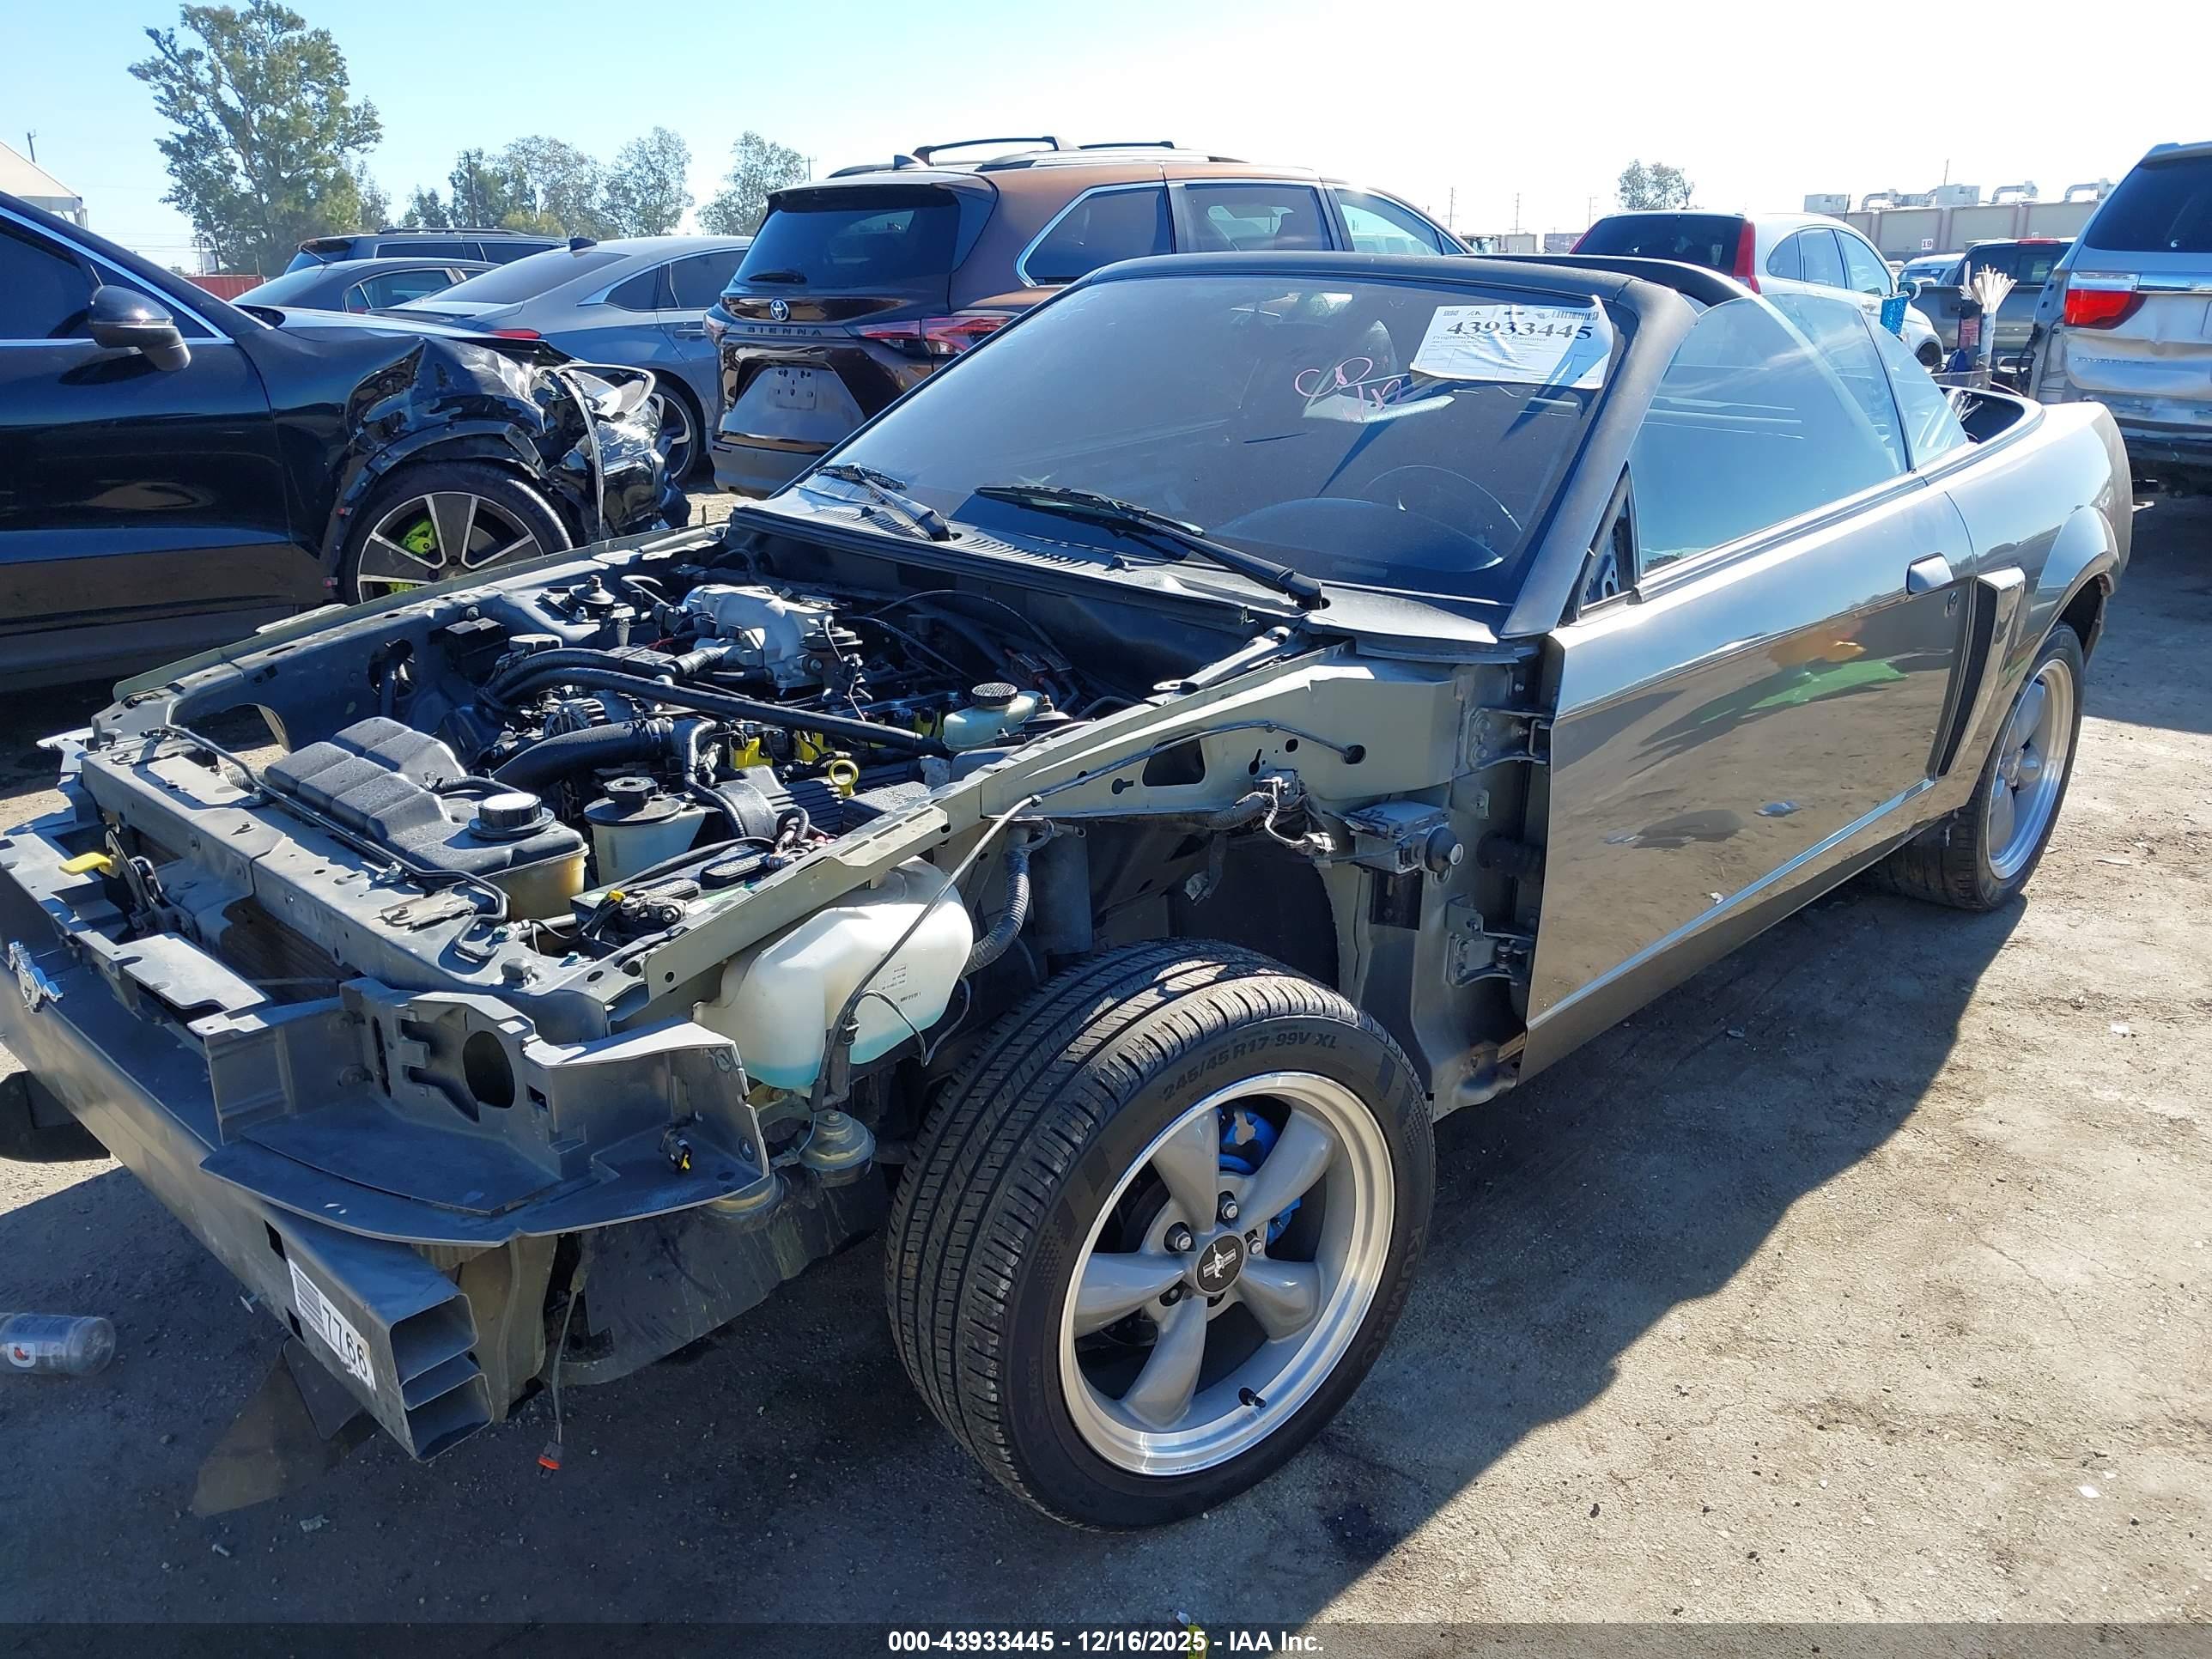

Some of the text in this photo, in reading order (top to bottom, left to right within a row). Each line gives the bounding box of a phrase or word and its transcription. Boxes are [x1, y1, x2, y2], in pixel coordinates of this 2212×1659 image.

[1922, 240, 1932, 248] 19
[747, 326, 823, 337] SIENNA
[1446, 320, 1595, 340] 43933445
[1163, 1049, 1230, 1103] 245/45
[1233, 1036, 1270, 1059] R17
[1274, 1031, 1310, 1048] 99V
[1313, 1033, 1338, 1049] XL
[321, 1304, 368, 1378] 7766
